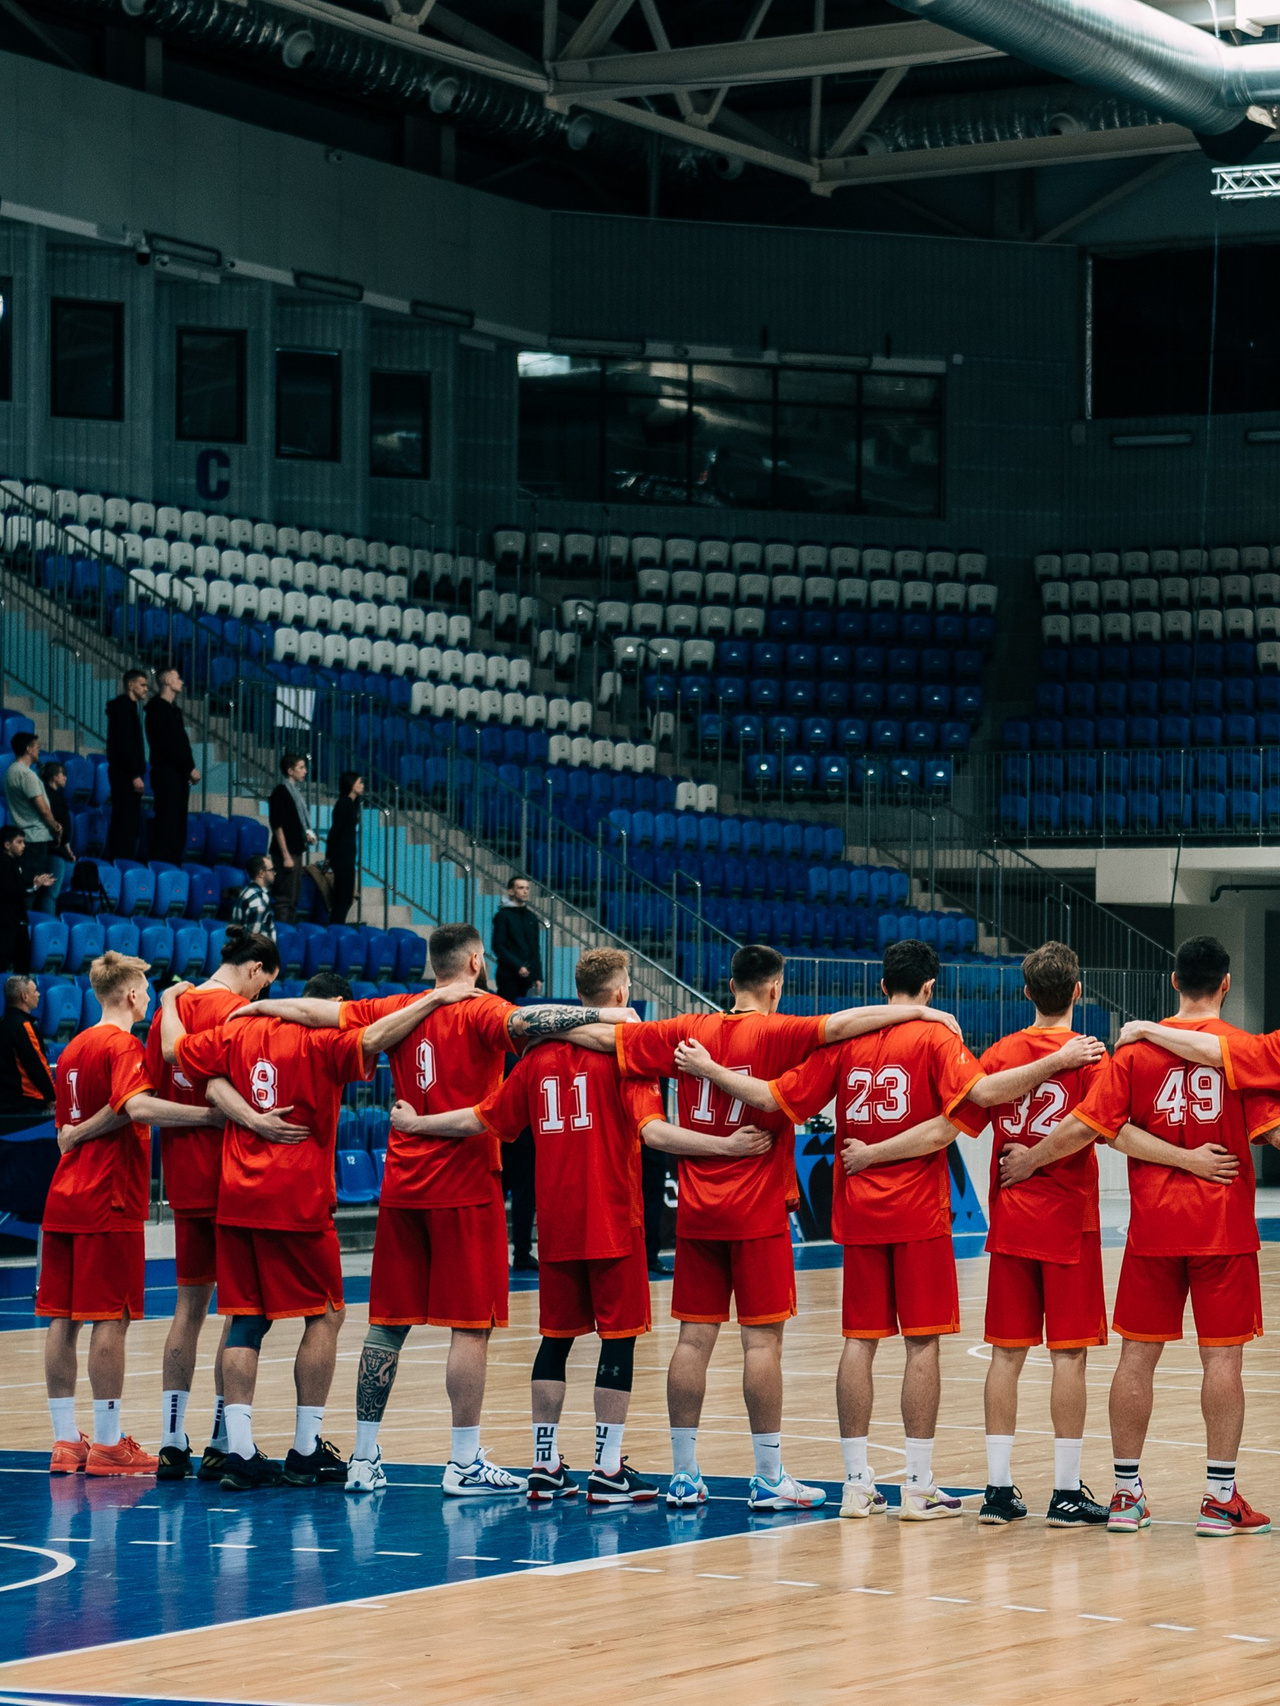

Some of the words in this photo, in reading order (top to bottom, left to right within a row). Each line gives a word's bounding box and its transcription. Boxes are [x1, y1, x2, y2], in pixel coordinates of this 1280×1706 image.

[250, 1057, 278, 1112] 8
[416, 1038, 437, 1094] 9
[689, 1065, 753, 1126] 17
[845, 1064, 912, 1124] 23
[1154, 1064, 1226, 1126] 49
[66, 1068, 82, 1124] 1
[539, 1072, 593, 1135] 11
[999, 1080, 1069, 1138] 32
